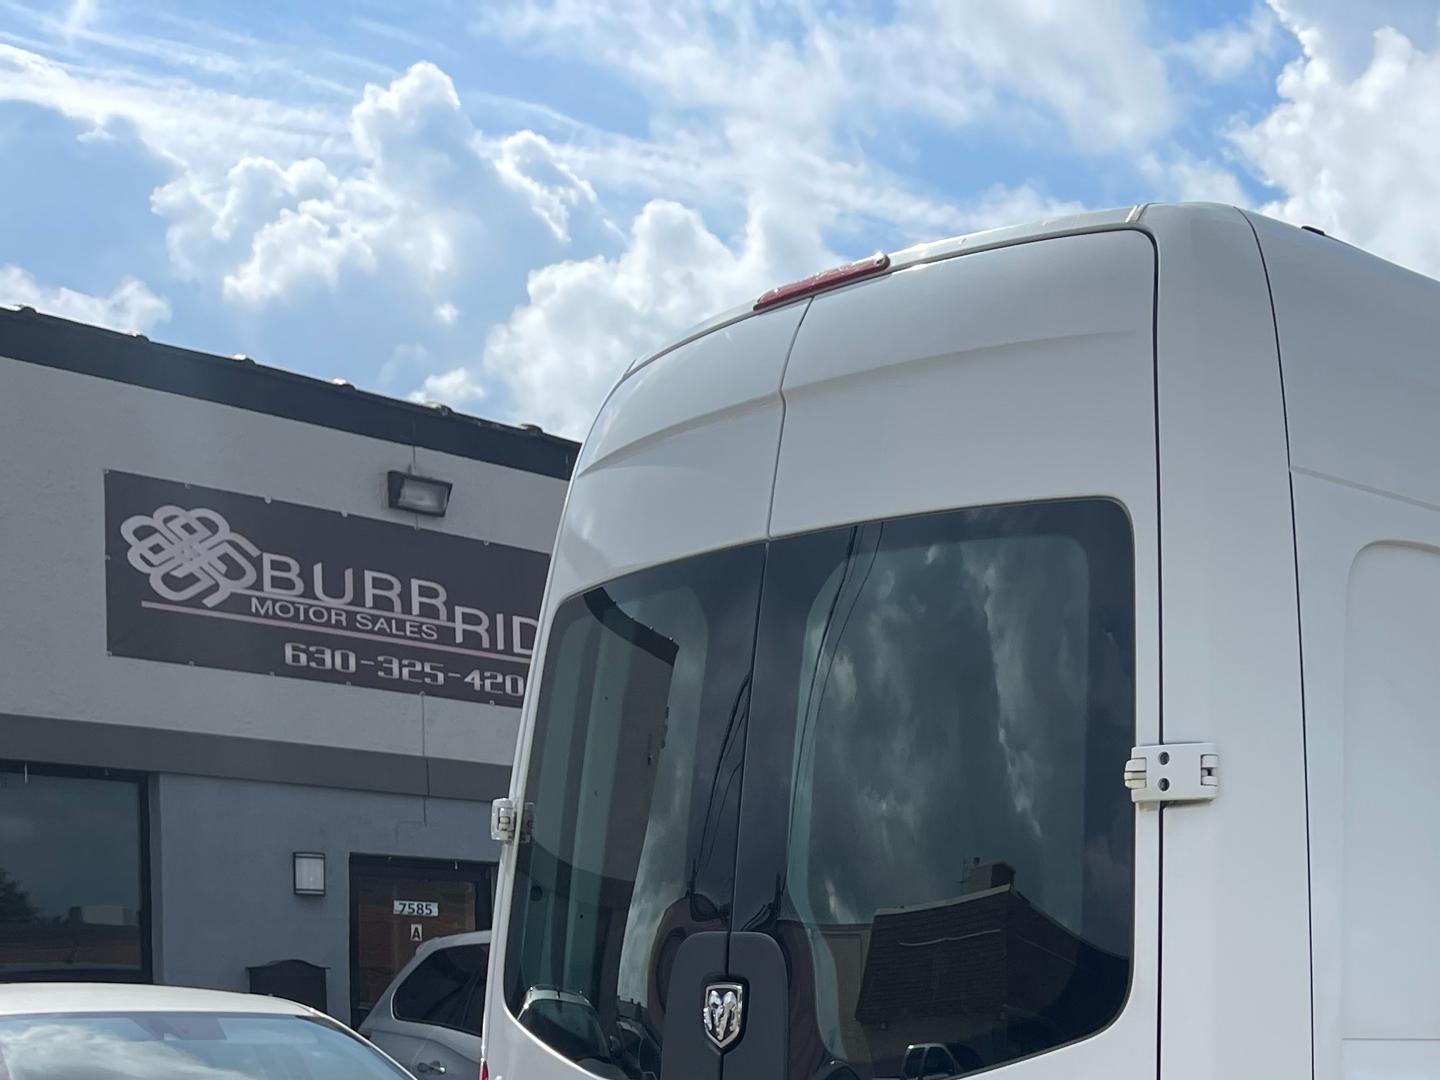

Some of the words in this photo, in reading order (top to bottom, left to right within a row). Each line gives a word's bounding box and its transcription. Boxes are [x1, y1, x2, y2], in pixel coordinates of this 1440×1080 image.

[262, 552, 448, 622] BURR
[251, 596, 347, 627] MOTOR
[356, 614, 438, 641] SALES
[399, 902, 433, 916] 7585
[412, 926, 421, 940] A
